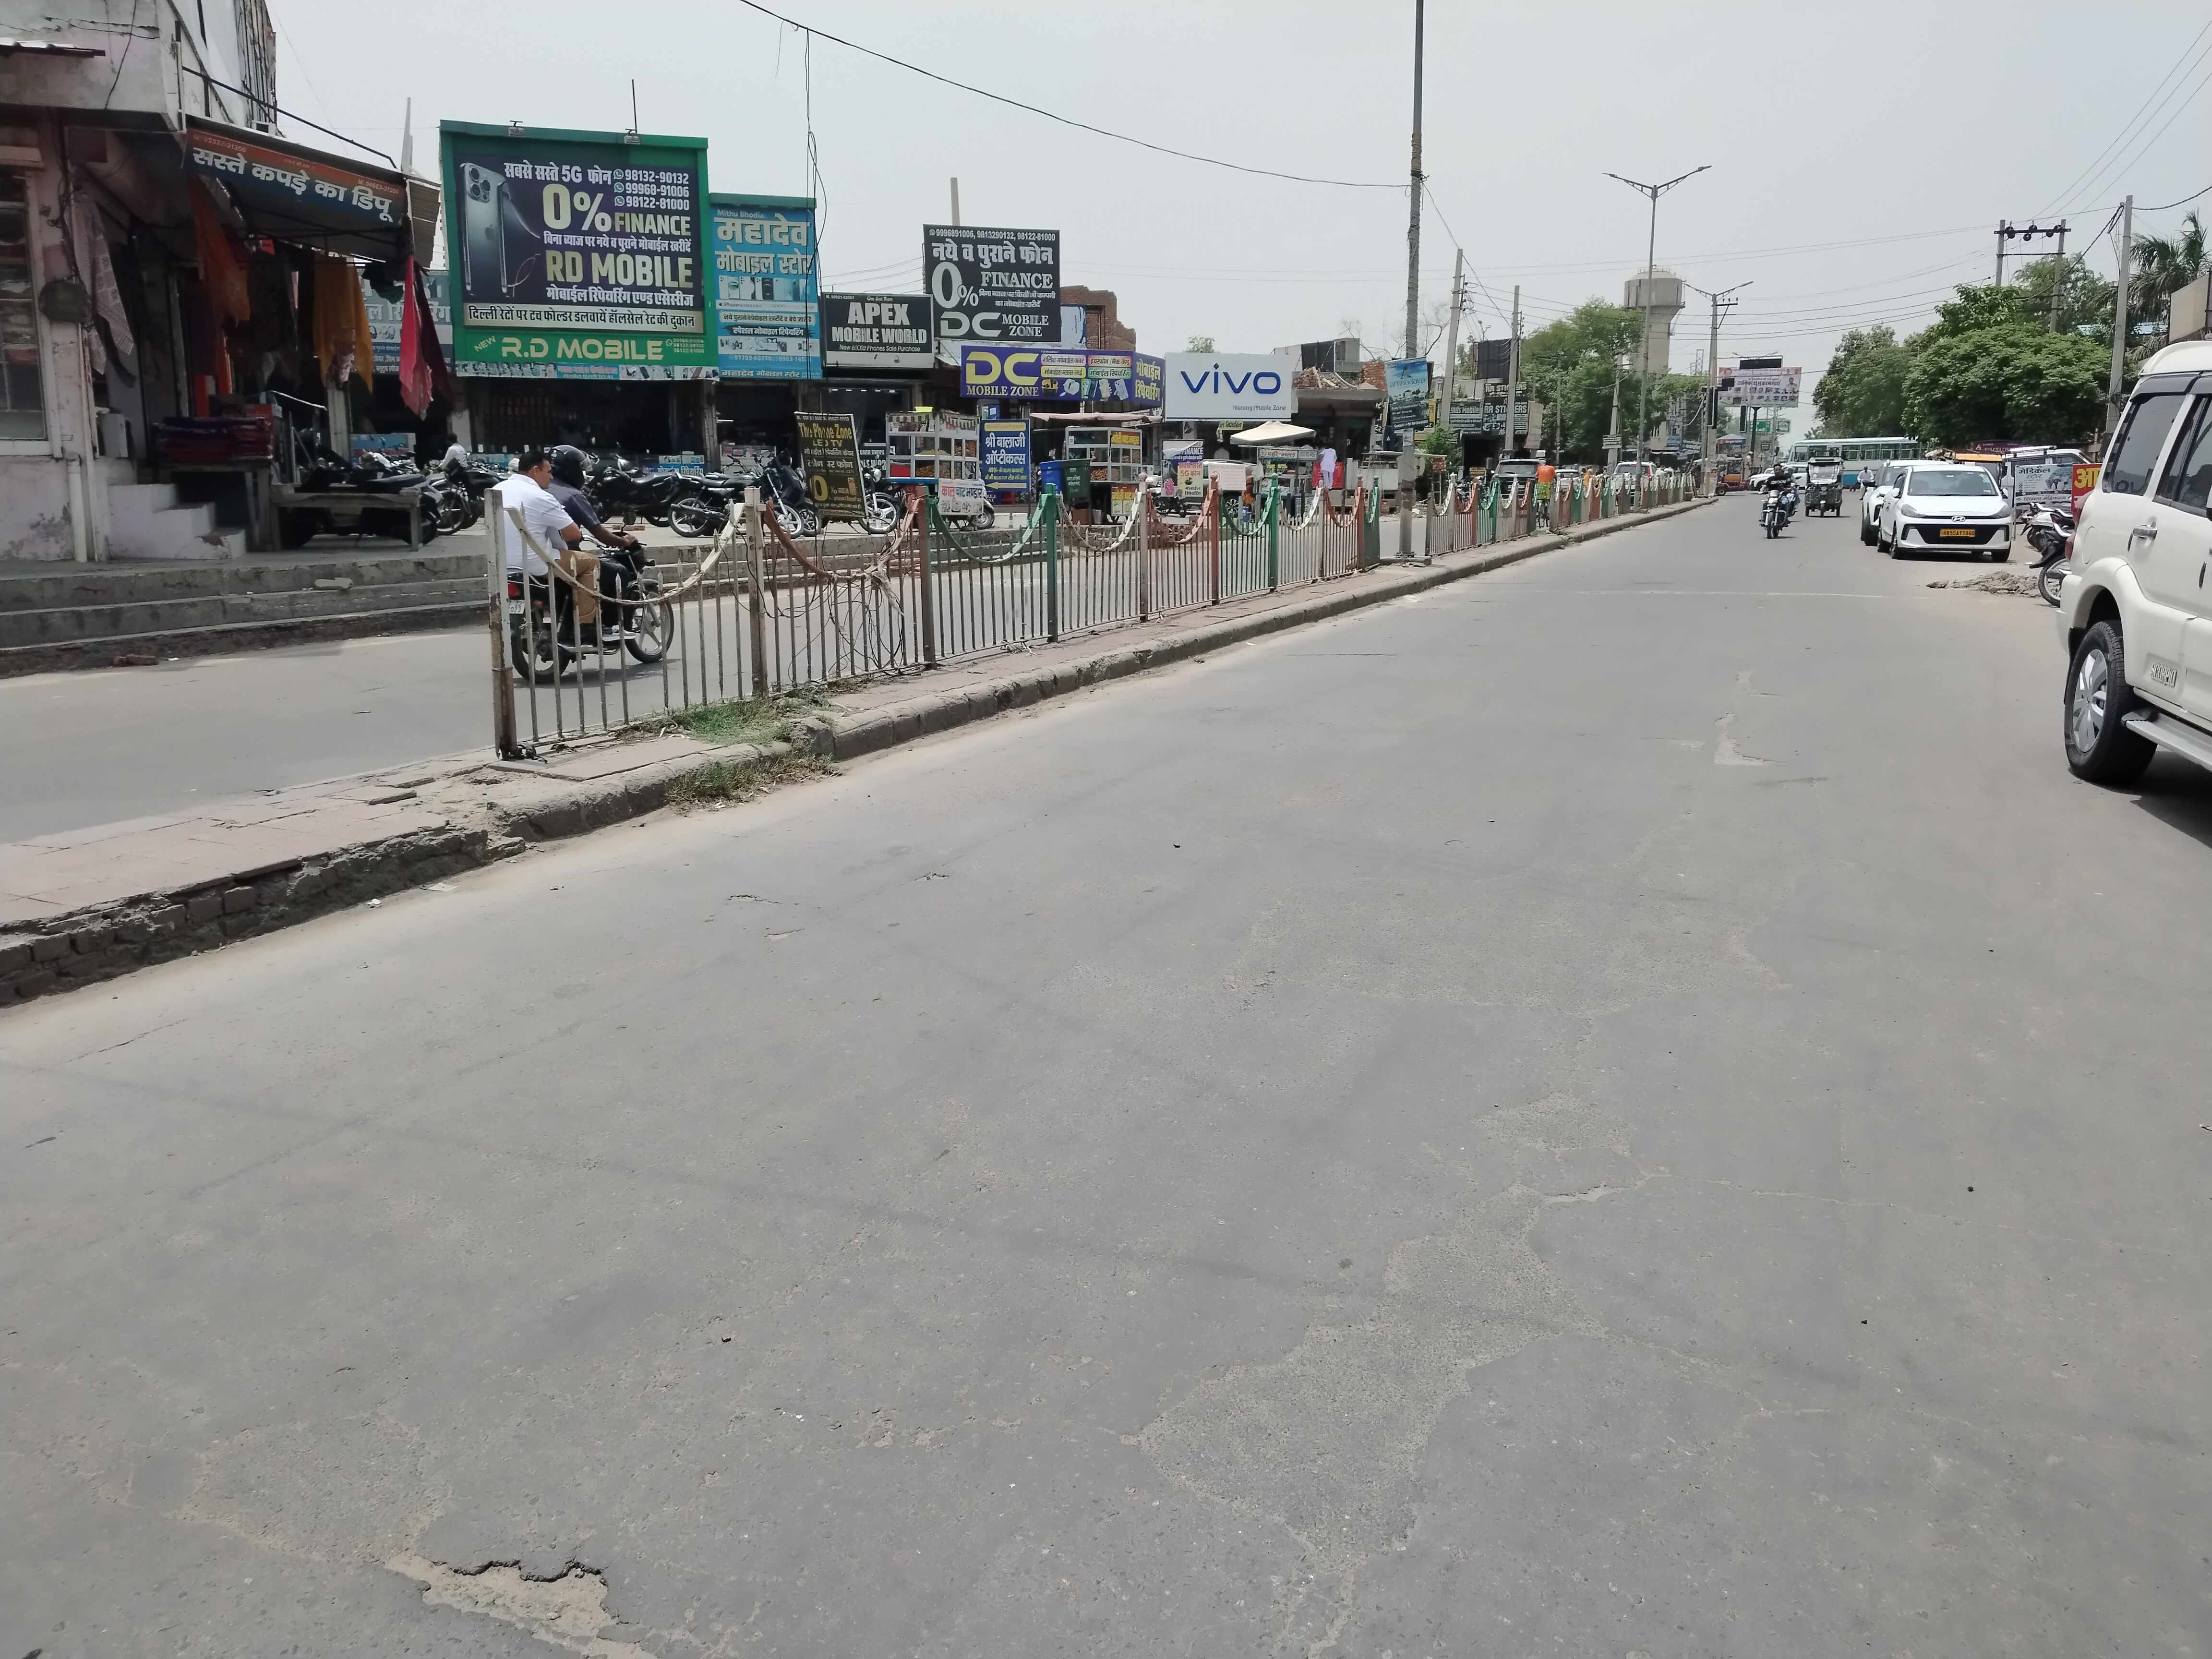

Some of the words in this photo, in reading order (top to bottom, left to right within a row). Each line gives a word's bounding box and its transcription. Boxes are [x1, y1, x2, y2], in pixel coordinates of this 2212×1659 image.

[504, 160, 532, 179] सबसे
[535, 162, 559, 181] सस्ते
[562, 165, 582, 183] 5G
[588, 165, 611, 184] फोन
[625, 169, 689, 184] 98132-90132
[193, 147, 247, 174] सस्ते
[252, 163, 310, 195] कपड़े
[314, 180, 347, 201] का
[352, 185, 393, 222] डिपू
[625, 182, 689, 197] 99968-91006
[542, 183, 612, 231] 0%
[615, 212, 691, 235] FINANCE
[626, 196, 690, 210] 98122-81000
[714, 213, 810, 246] महादेव
[936, 229, 975, 239] 9996891006,
[977, 230, 1016, 240] 9813290132,
[1017, 232, 1056, 240] 98122-81000
[544, 230, 562, 245] बिना
[564, 235, 583, 246] ब्याज
[585, 236, 595, 247] पर
[597, 234, 609, 248] नये
[611, 237, 616, 248] व
[618, 236, 637, 252] पुराने
[638, 236, 668, 252] मोबाईल
[670, 238, 691, 252] खरीदें
[715, 245, 775, 275] मोबाइल
[777, 248, 813, 275] स्टोर
[932, 238, 958, 261] नये
[962, 244, 974, 261] व
[977, 240, 1016, 268] पुराने
[1019, 241, 1053, 264] फोन
[546, 250, 583, 282] RD
[591, 252, 693, 288] MOBILE
[546, 284, 587, 302] मोबाईल
[589, 286, 630, 304] रिपेयरिंग
[632, 291, 653, 304] एण्ड
[932, 261, 979, 308] 0%
[981, 272, 1053, 289] FINANCE
[469, 306, 497, 320] दिल्ली
[497, 306, 514, 320] रेटों
[516, 310, 528, 320] पर
[529, 310, 541, 321] टच
[544, 307, 572, 321] फोल्डर
[575, 309, 606, 323] डलवायें
[609, 309, 643, 324] हॉलसेल
[643, 311, 655, 325] रेट
[657, 312, 668, 325] की
[670, 315, 695, 329] दुकान
[848, 302, 910, 325] APEX
[940, 311, 1002, 337] DC
[1002, 314, 1049, 325] MOBILE
[832, 327, 879, 343] MOBILE
[881, 328, 927, 343] WORLD
[1009, 326, 1043, 337] ZONE
[474, 336, 495, 352] NEW
[502, 337, 548, 358] R.D
[557, 338, 664, 360] MOBILE
[966, 351, 1039, 385] DC
[1136, 358, 1161, 381] मोबाईल
[1180, 362, 1281, 394] vivo
[967, 385, 1008, 396] MOBILE
[1010, 386, 1039, 397] ZONE
[1496, 384, 1527, 392] STIERS
[1495, 405, 1527, 414] STIERS
[834, 424, 853, 439] Zone
[986, 432, 996, 447] श्री
[997, 432, 1026, 448] बालाजी
[836, 459, 853, 468] फोन
[986, 449, 1026, 464] ऑप्टीकल्स
[2151, 663, 2177, 687] SCORPIO
